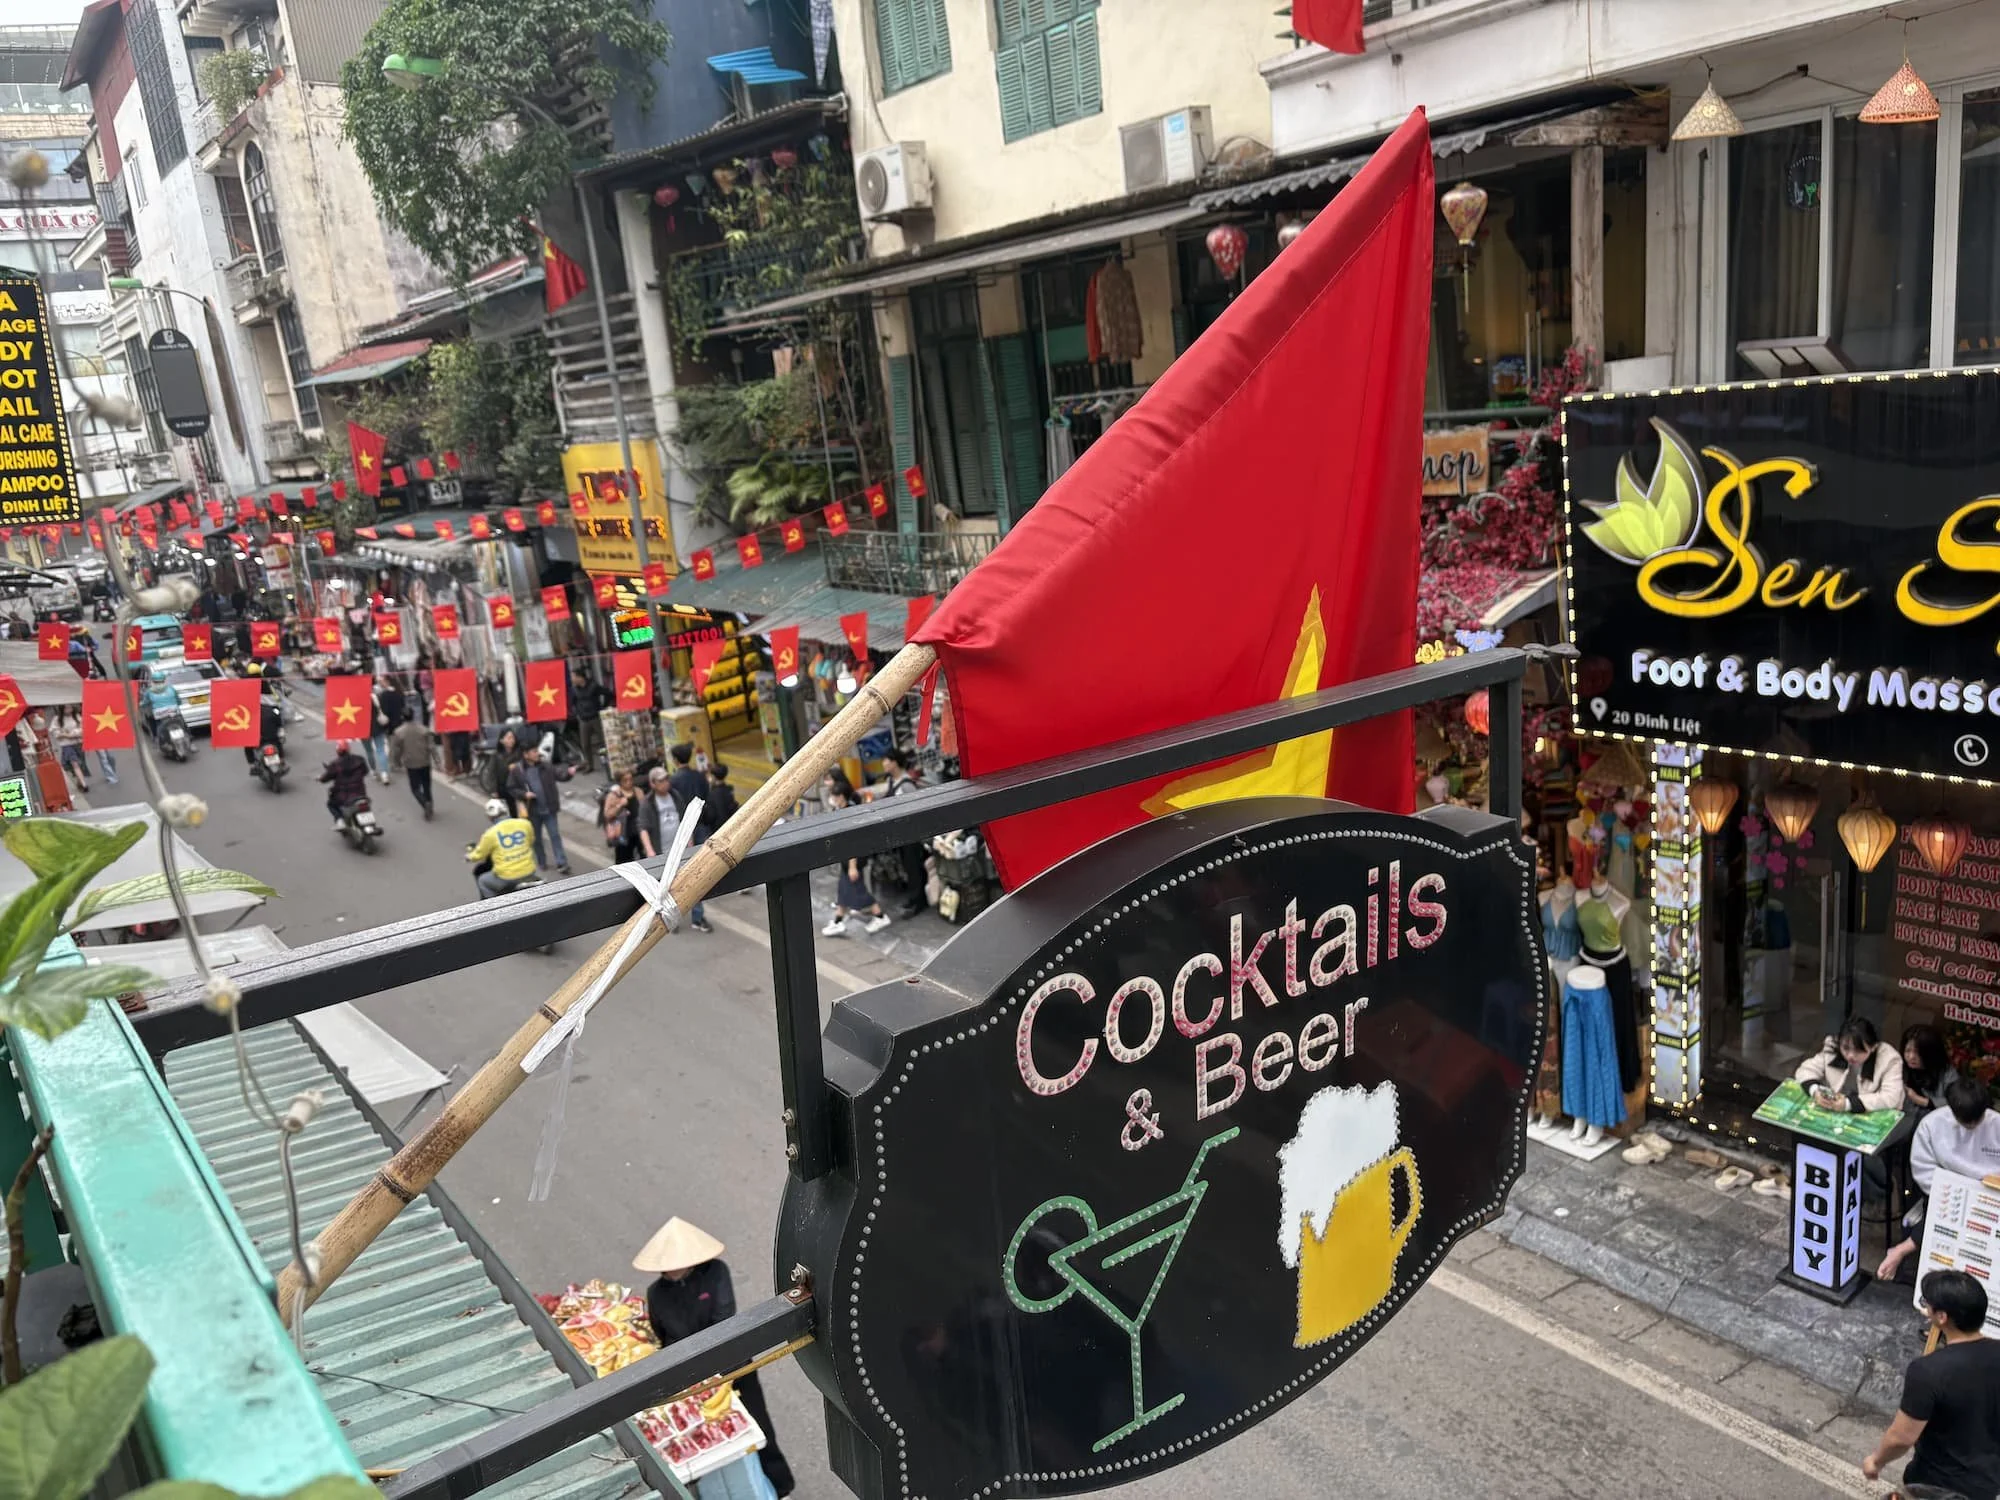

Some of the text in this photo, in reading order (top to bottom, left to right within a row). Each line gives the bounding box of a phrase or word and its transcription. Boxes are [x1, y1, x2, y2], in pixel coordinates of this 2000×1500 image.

[0, 341, 33, 361] DY
[0, 368, 37, 389] OT
[0, 397, 39, 417] AIL
[19, 423, 55, 443] CARE
[0, 474, 64, 494] AMPOO
[2, 495, 68, 514] ĐINH LIỆT
[1637, 446, 1866, 618] Sen
[1631, 650, 1710, 689] Foot
[1716, 657, 1745, 692] &
[1757, 659, 1857, 713] Body
[1612, 710, 1701, 737] 20 Đinh Liệt
[497, 830, 526, 849] be
[1897, 873, 1941, 899] BODY
[1896, 896, 1980, 932] FACE CARE
[1895, 922, 1918, 943] HOT
[1918, 926, 1957, 953] STONE
[1016, 859, 1448, 1097] Cocktails
[1905, 950, 1997, 985] Gel color
[1898, 978, 1982, 1007] Nourishing
[1121, 997, 1369, 1151] & Beer
[1803, 1162, 1830, 1271] BODY
[1845, 1158, 1860, 1270] NAIL
